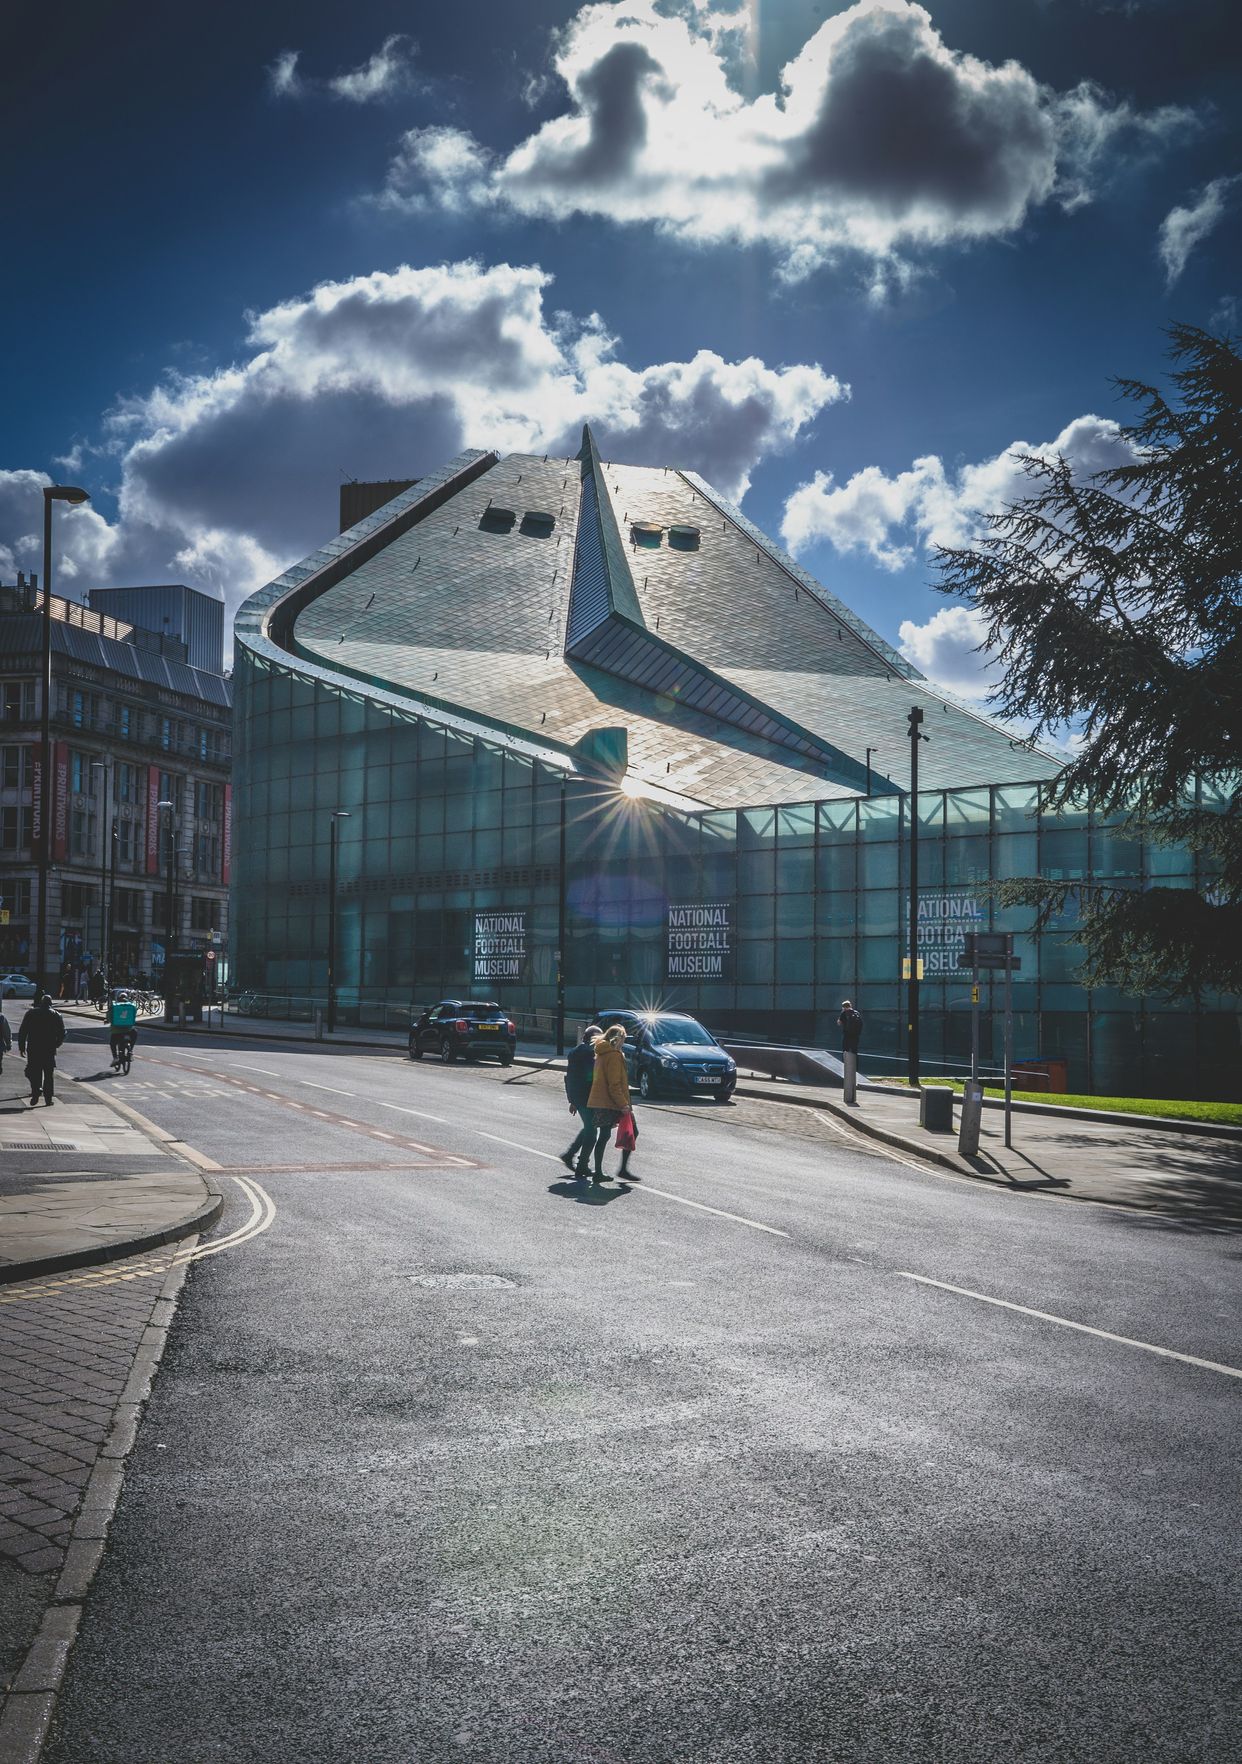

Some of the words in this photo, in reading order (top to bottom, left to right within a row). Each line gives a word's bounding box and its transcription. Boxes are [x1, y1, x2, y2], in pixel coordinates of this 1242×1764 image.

[55, 768, 67, 841] PRINTWORKS
[147, 789, 158, 856] PRINTWORKS
[475, 916, 525, 934] NATIONAL
[668, 908, 730, 927] NATIONAL
[474, 937, 526, 955] FOOTBALL
[668, 931, 731, 950] FOOTBALL
[474, 959, 520, 976] MUSEUM
[668, 955, 723, 974] MUSEUM
[907, 951, 970, 971] USEU
[111, 1080, 213, 1090] BUS
[110, 1089, 248, 1101] STOP
